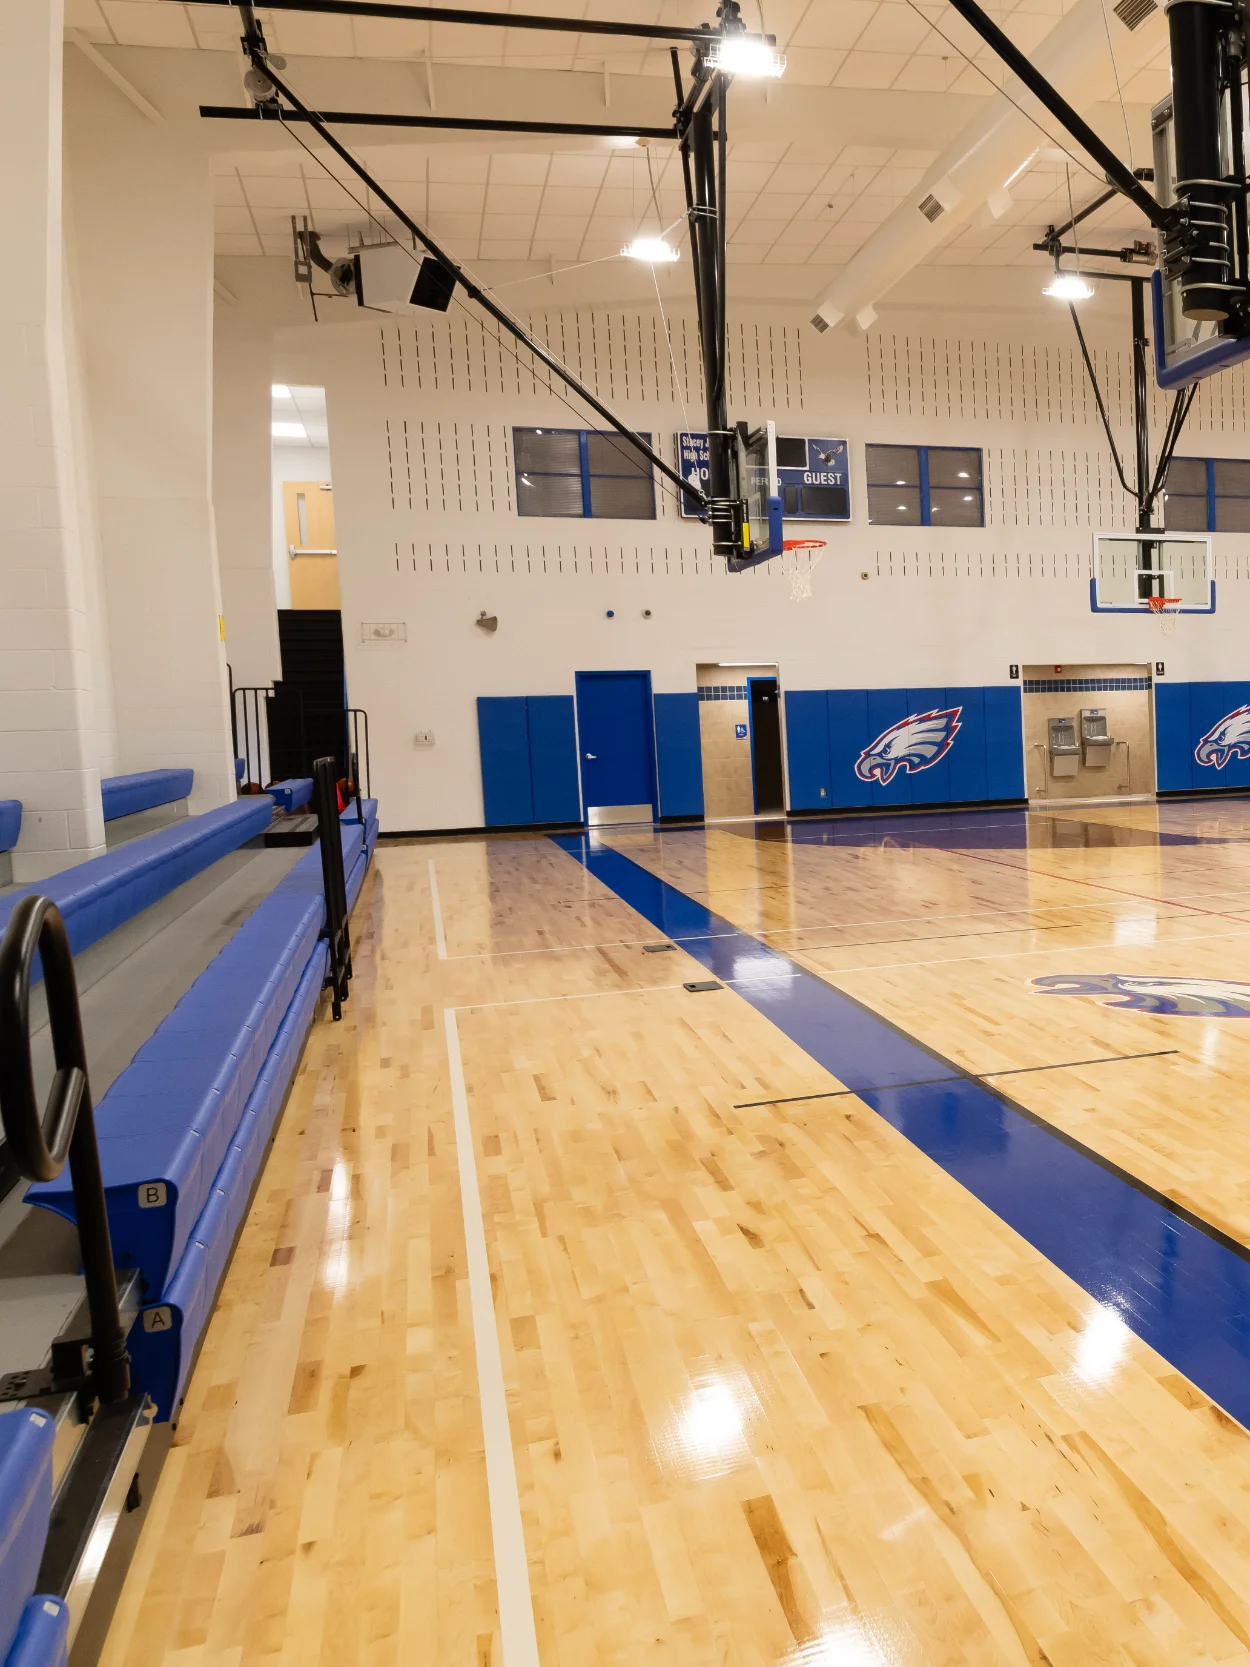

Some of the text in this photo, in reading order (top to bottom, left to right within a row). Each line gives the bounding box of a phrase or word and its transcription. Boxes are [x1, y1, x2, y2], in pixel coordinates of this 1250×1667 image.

[682, 436, 704, 449] Stacey
[683, 449, 699, 462] High
[750, 476, 782, 487] PERD
[803, 472, 842, 485] GUEST
[146, 1187, 160, 1204] B
[151, 1311, 166, 1329] A
